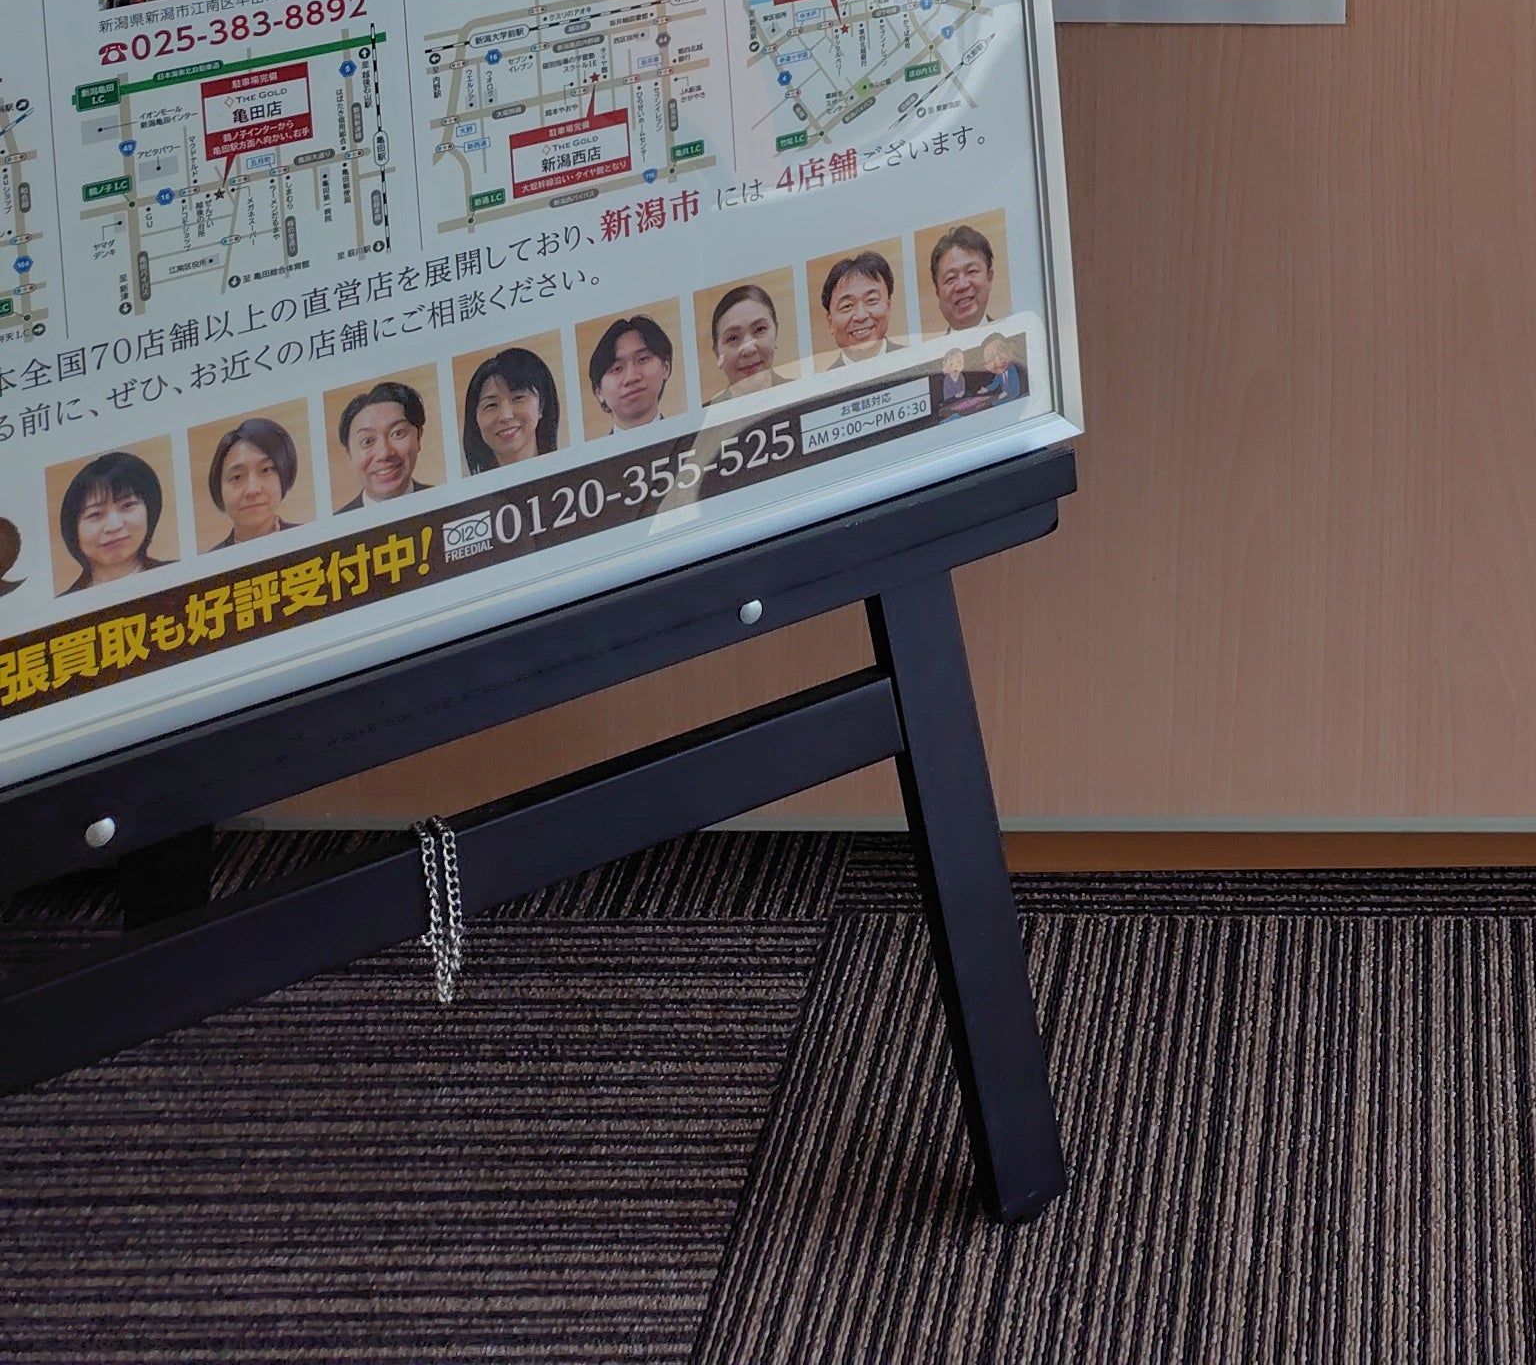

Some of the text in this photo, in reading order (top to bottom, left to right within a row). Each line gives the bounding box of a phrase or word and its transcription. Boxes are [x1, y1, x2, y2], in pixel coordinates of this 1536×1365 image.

[233, 101, 283, 124] 亀田店
[540, 146, 602, 173] 新潟西店
[840, 391, 893, 418] お電話対応
[495, 419, 796, 545] 0120-355-525
[445, 540, 494, 563] FREEDIAL
